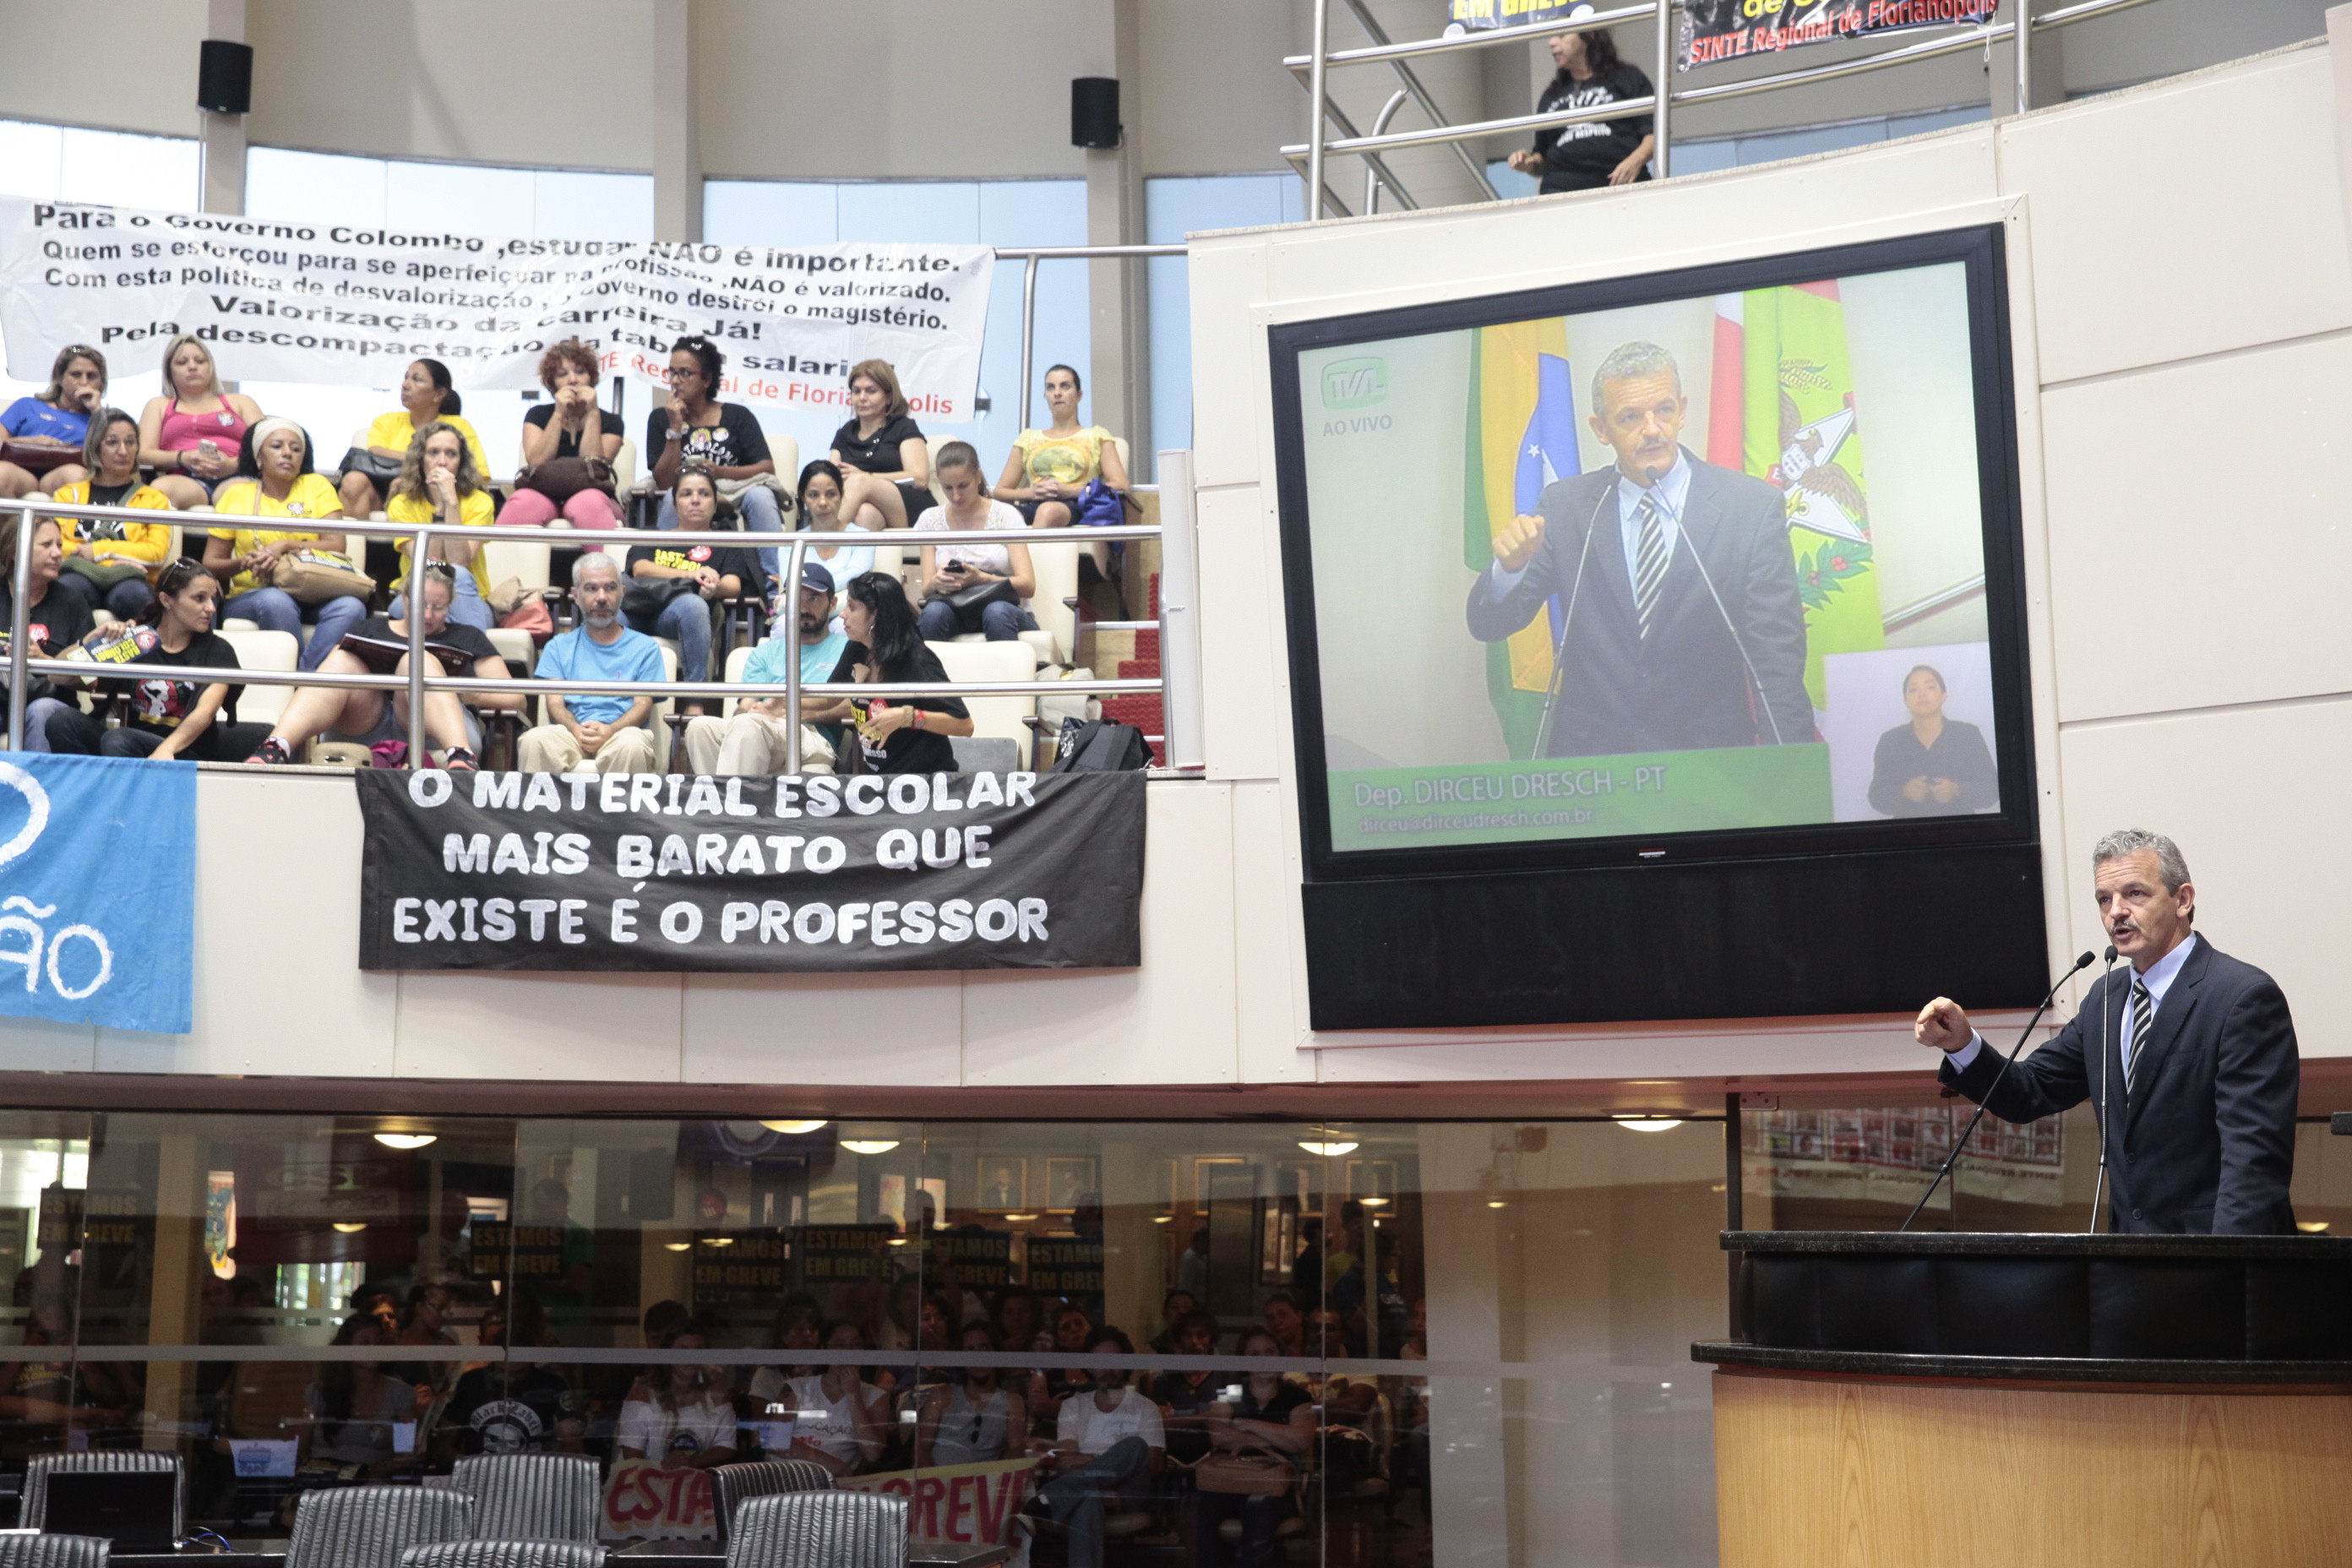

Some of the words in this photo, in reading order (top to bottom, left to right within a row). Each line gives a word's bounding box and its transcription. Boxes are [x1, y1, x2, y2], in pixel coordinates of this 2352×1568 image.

[1690, 30, 1746, 64] SINTE
[1752, 10, 1833, 52] Regional
[1838, 7, 1863, 32] de
[34, 204, 117, 229] Para
[130, 215, 151, 227] o
[165, 215, 316, 241] Governo
[329, 226, 484, 253] Colombo
[733, 246, 754, 267] é
[765, 248, 961, 276] importante.
[43, 240, 122, 261] Quem
[131, 242, 161, 259] se
[171, 241, 288, 265] esforçou
[297, 252, 357, 272] para
[367, 258, 397, 275] se
[406, 261, 555, 285] aperfeiçoar
[565, 270, 593, 284] na
[795, 280, 809, 297] é
[818, 281, 951, 302] valorizado.
[45, 267, 107, 288] Com
[117, 267, 172, 287] esta
[181, 265, 282, 291] política
[292, 277, 324, 296] de
[334, 280, 533, 311] desvalorização
[784, 304, 798, 315] o
[807, 304, 949, 330] magistério.
[210, 295, 459, 332] Valorização
[474, 317, 521, 332] da
[536, 306, 688, 333] carreira
[702, 319, 761, 340] Já!
[101, 321, 181, 343] Pela
[742, 355, 895, 378] salari
[631, 354, 739, 394] Regal
[748, 379, 779, 399] de
[787, 383, 954, 414] Floriolis
[1323, 420, 1348, 437] AO
[1350, 414, 1393, 433] VIVO
[408, 769, 453, 808] O
[473, 770, 758, 817] MATERIAL
[776, 771, 1037, 818] ESCOLAR
[1354, 781, 1408, 811] Dep.
[1415, 776, 1504, 804] DIRCEU
[1511, 770, 1612, 799] DRESCH
[1635, 765, 1667, 792] PT
[1358, 806, 1593, 835] dirceu@dirceudresch.com.br
[443, 832, 591, 876] MAIS
[617, 834, 847, 878] BARATO
[876, 825, 993, 871] QUE
[393, 896, 587, 945] EXISTE
[611, 881, 640, 944] É
[660, 901, 703, 945] O
[721, 896, 1049, 947] PROFESSOR
[806, 1257, 831, 1277] EM
[925, 1236, 1007, 1257] STAMOS
[1032, 1244, 1104, 1265] ESTAMO
[696, 1264, 721, 1284] EM
[726, 1266, 782, 1286] GREVE
[954, 1266, 1007, 1285] GREVE
[1032, 1271, 1058, 1290] EM
[1061, 1271, 1104, 1291] GRE
[607, 1466, 716, 1524] ESTA
